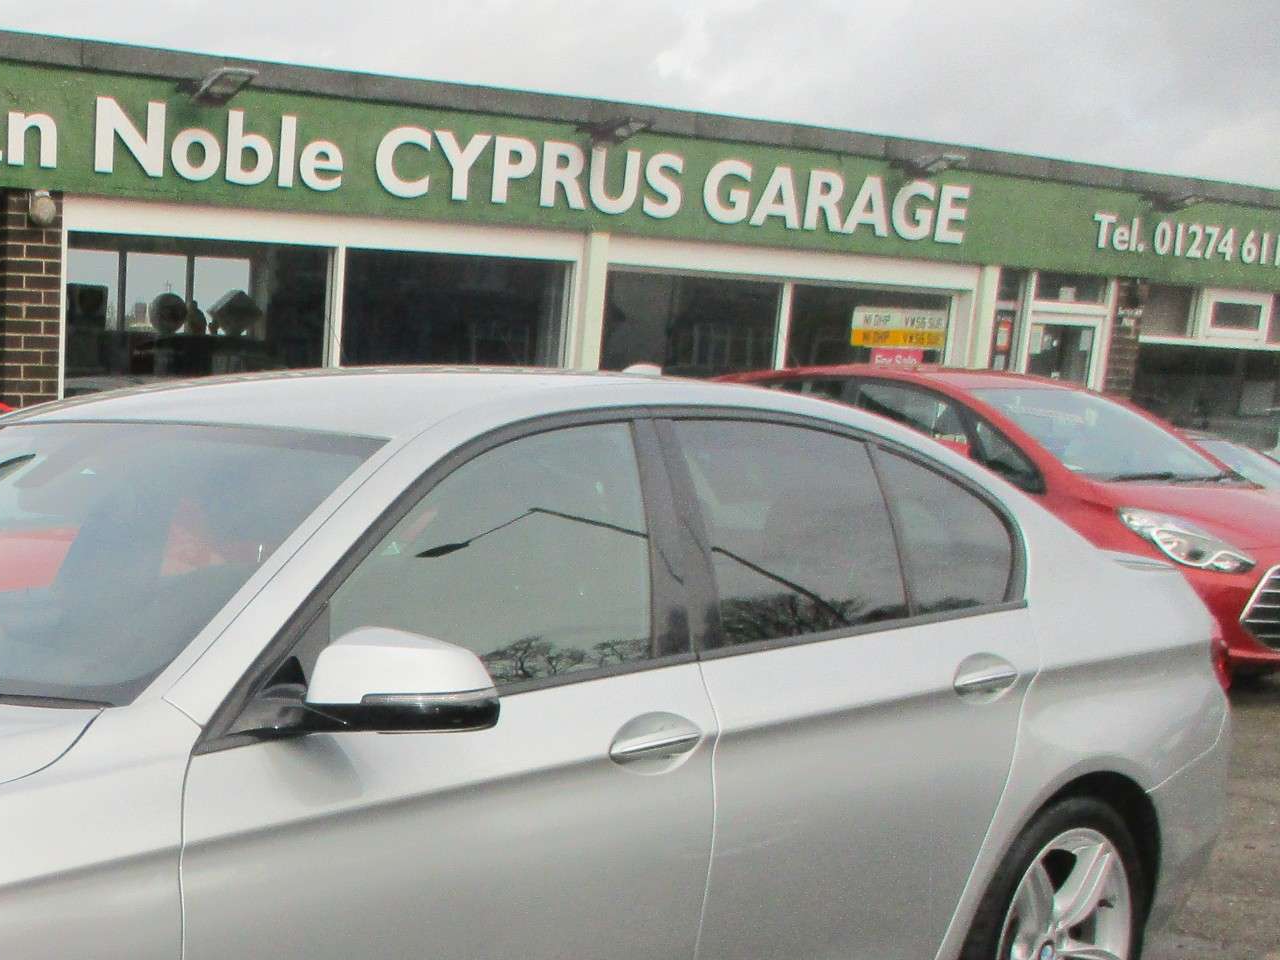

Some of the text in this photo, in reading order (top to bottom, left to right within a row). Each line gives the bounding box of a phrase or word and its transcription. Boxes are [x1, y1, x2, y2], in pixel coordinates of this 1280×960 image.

[94, 96, 345, 192] Noble
[375, 126, 684, 217] CYPRUS
[704, 159, 971, 244] GARAGE
[1093, 211, 1145, 252] Tel.
[1154, 221, 1236, 262] 01274
